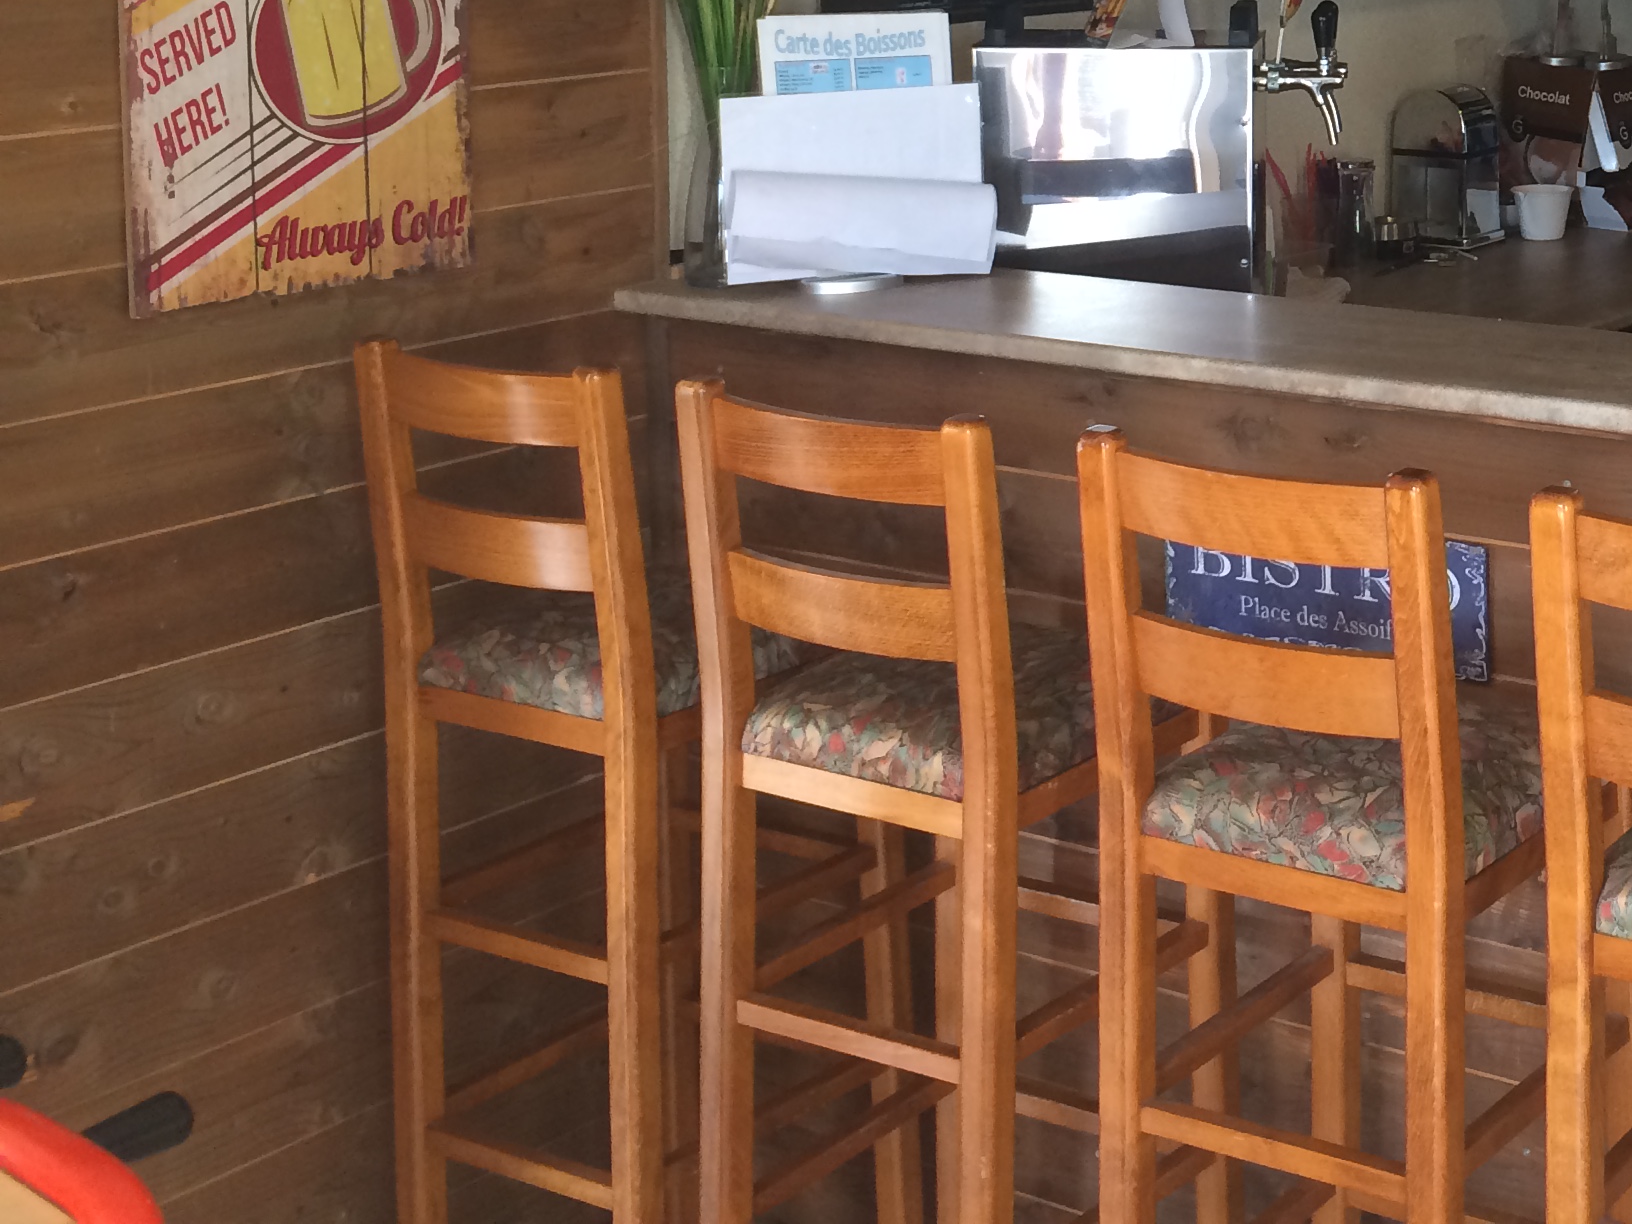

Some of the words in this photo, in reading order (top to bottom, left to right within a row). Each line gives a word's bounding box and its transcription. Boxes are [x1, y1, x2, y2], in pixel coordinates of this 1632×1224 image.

[140, 1, 236, 95] SERVED
[774, 29, 820, 56] Carte
[823, 31, 852, 57] des
[855, 28, 926, 56] Boissons
[1517, 85, 1571, 106] Chocolat
[153, 82, 230, 168] HERE!
[257, 213, 384, 270] Always
[392, 195, 469, 249] Cold!
[1238, 595, 1291, 624] Place
[1296, 606, 1328, 631] des
